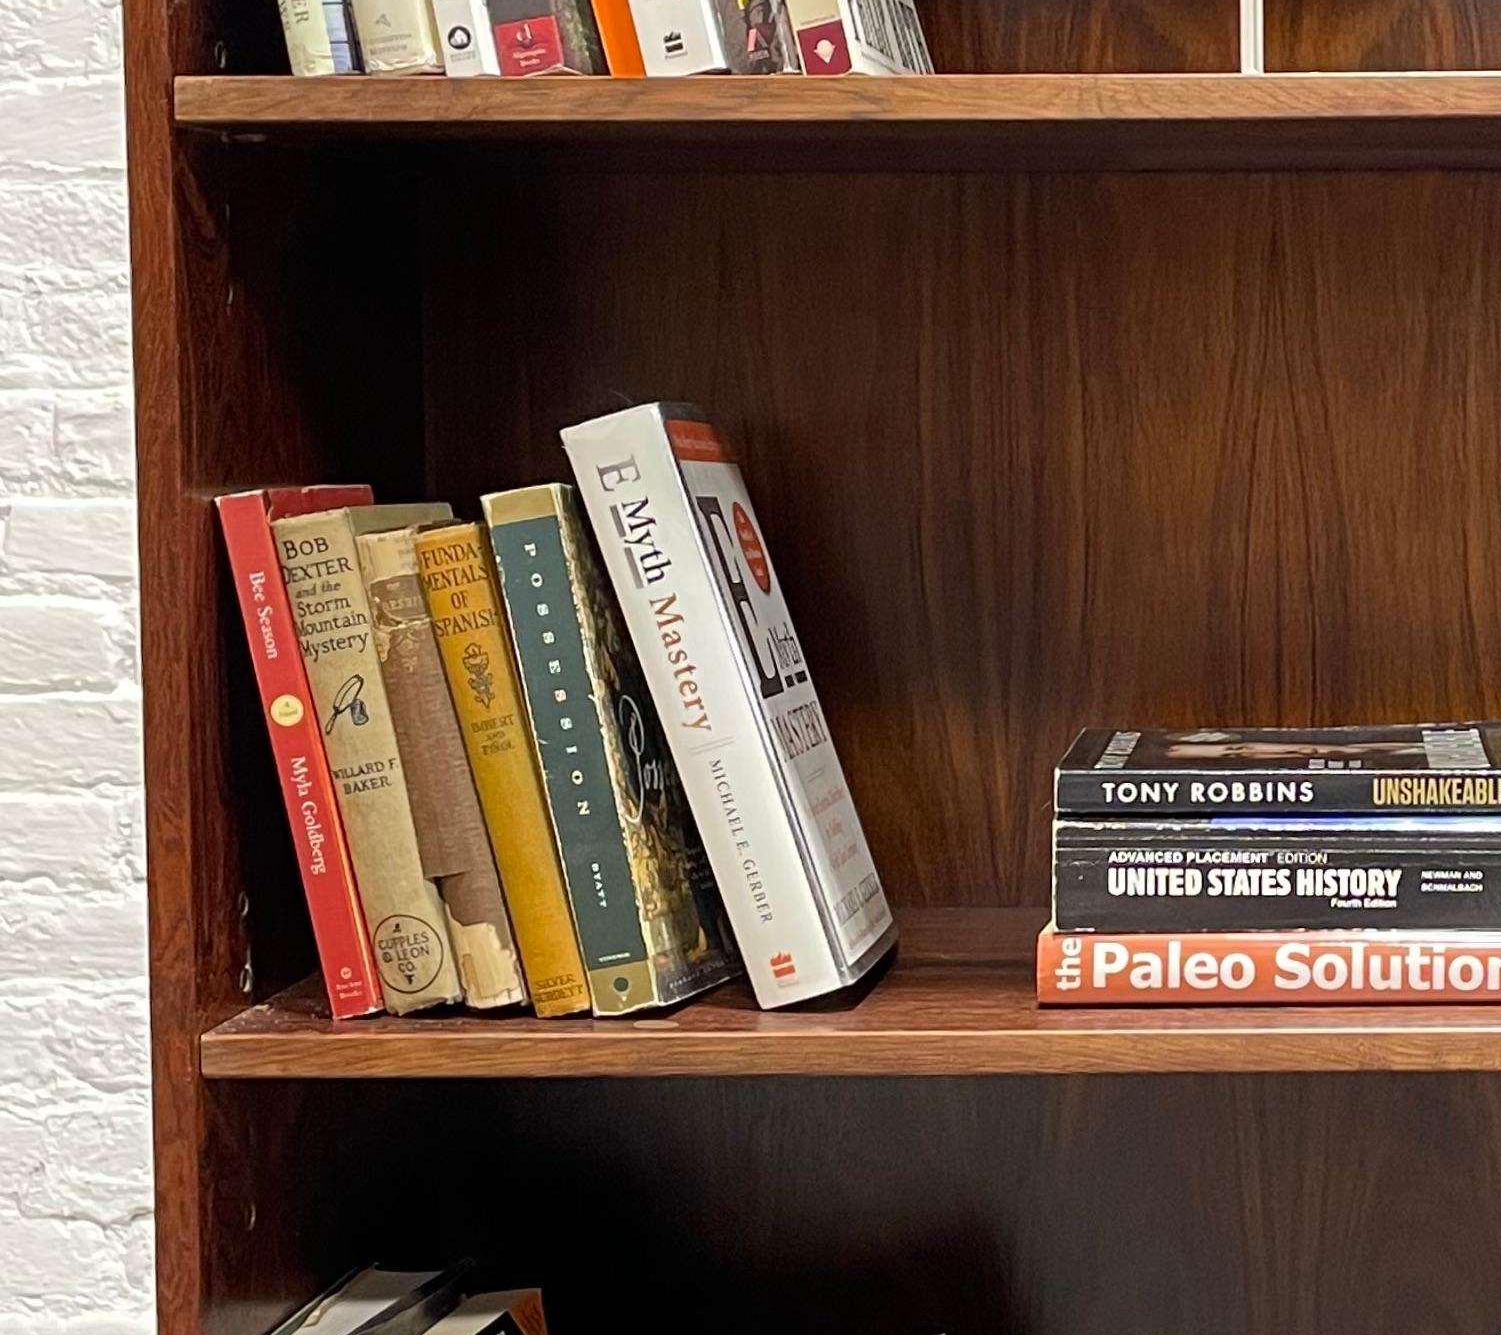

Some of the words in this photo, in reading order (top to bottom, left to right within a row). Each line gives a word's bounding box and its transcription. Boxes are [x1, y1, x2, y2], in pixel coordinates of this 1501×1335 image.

[282, 536, 330, 560] BOB
[282, 556, 354, 585] DEXTER
[424, 564, 491, 592] MENTALS
[247, 570, 268, 604] Bee
[296, 583, 318, 599] and
[320, 579, 342, 593] the
[451, 590, 470, 610] OF
[597, 454, 641, 492] E
[621, 495, 673, 586] Myth
[648, 592, 713, 733] Mastery
[297, 596, 351, 618] Storm
[255, 603, 280, 662] Season
[302, 632, 369, 663] Mystery
[523, 542, 592, 818] POSSESSION
[771, 700, 828, 763] MASTERY
[289, 754, 310, 799] Myla
[331, 760, 386, 780] WILLARD
[342, 776, 393, 795] BAKER
[709, 758, 745, 837] MICHAEL
[1101, 781, 1180, 804] TONY
[1190, 780, 1316, 804] ROBBINS
[295, 799, 328, 876] Goldberg
[735, 839, 751, 857] E.
[1108, 850, 1184, 864] ADVANCED
[1186, 850, 1269, 864] PLACEMENT
[1276, 851, 1328, 865] EDITION
[591, 861, 607, 910] BYATT
[1107, 867, 1203, 897] UNITED
[1206, 867, 1291, 897] STATES
[1296, 868, 1403, 898] HISTORY
[1420, 870, 1462, 880] NEWMAN
[1463, 870, 1484, 880] AND
[742, 857, 774, 925] GERBER
[1363, 897, 1398, 909] Edition
[377, 931, 430, 951] CUPPLES
[395, 944, 431, 962] LEON
[1055, 937, 1083, 991] the
[1092, 940, 1256, 990] Paleo
[535, 973, 577, 989] SILVER
